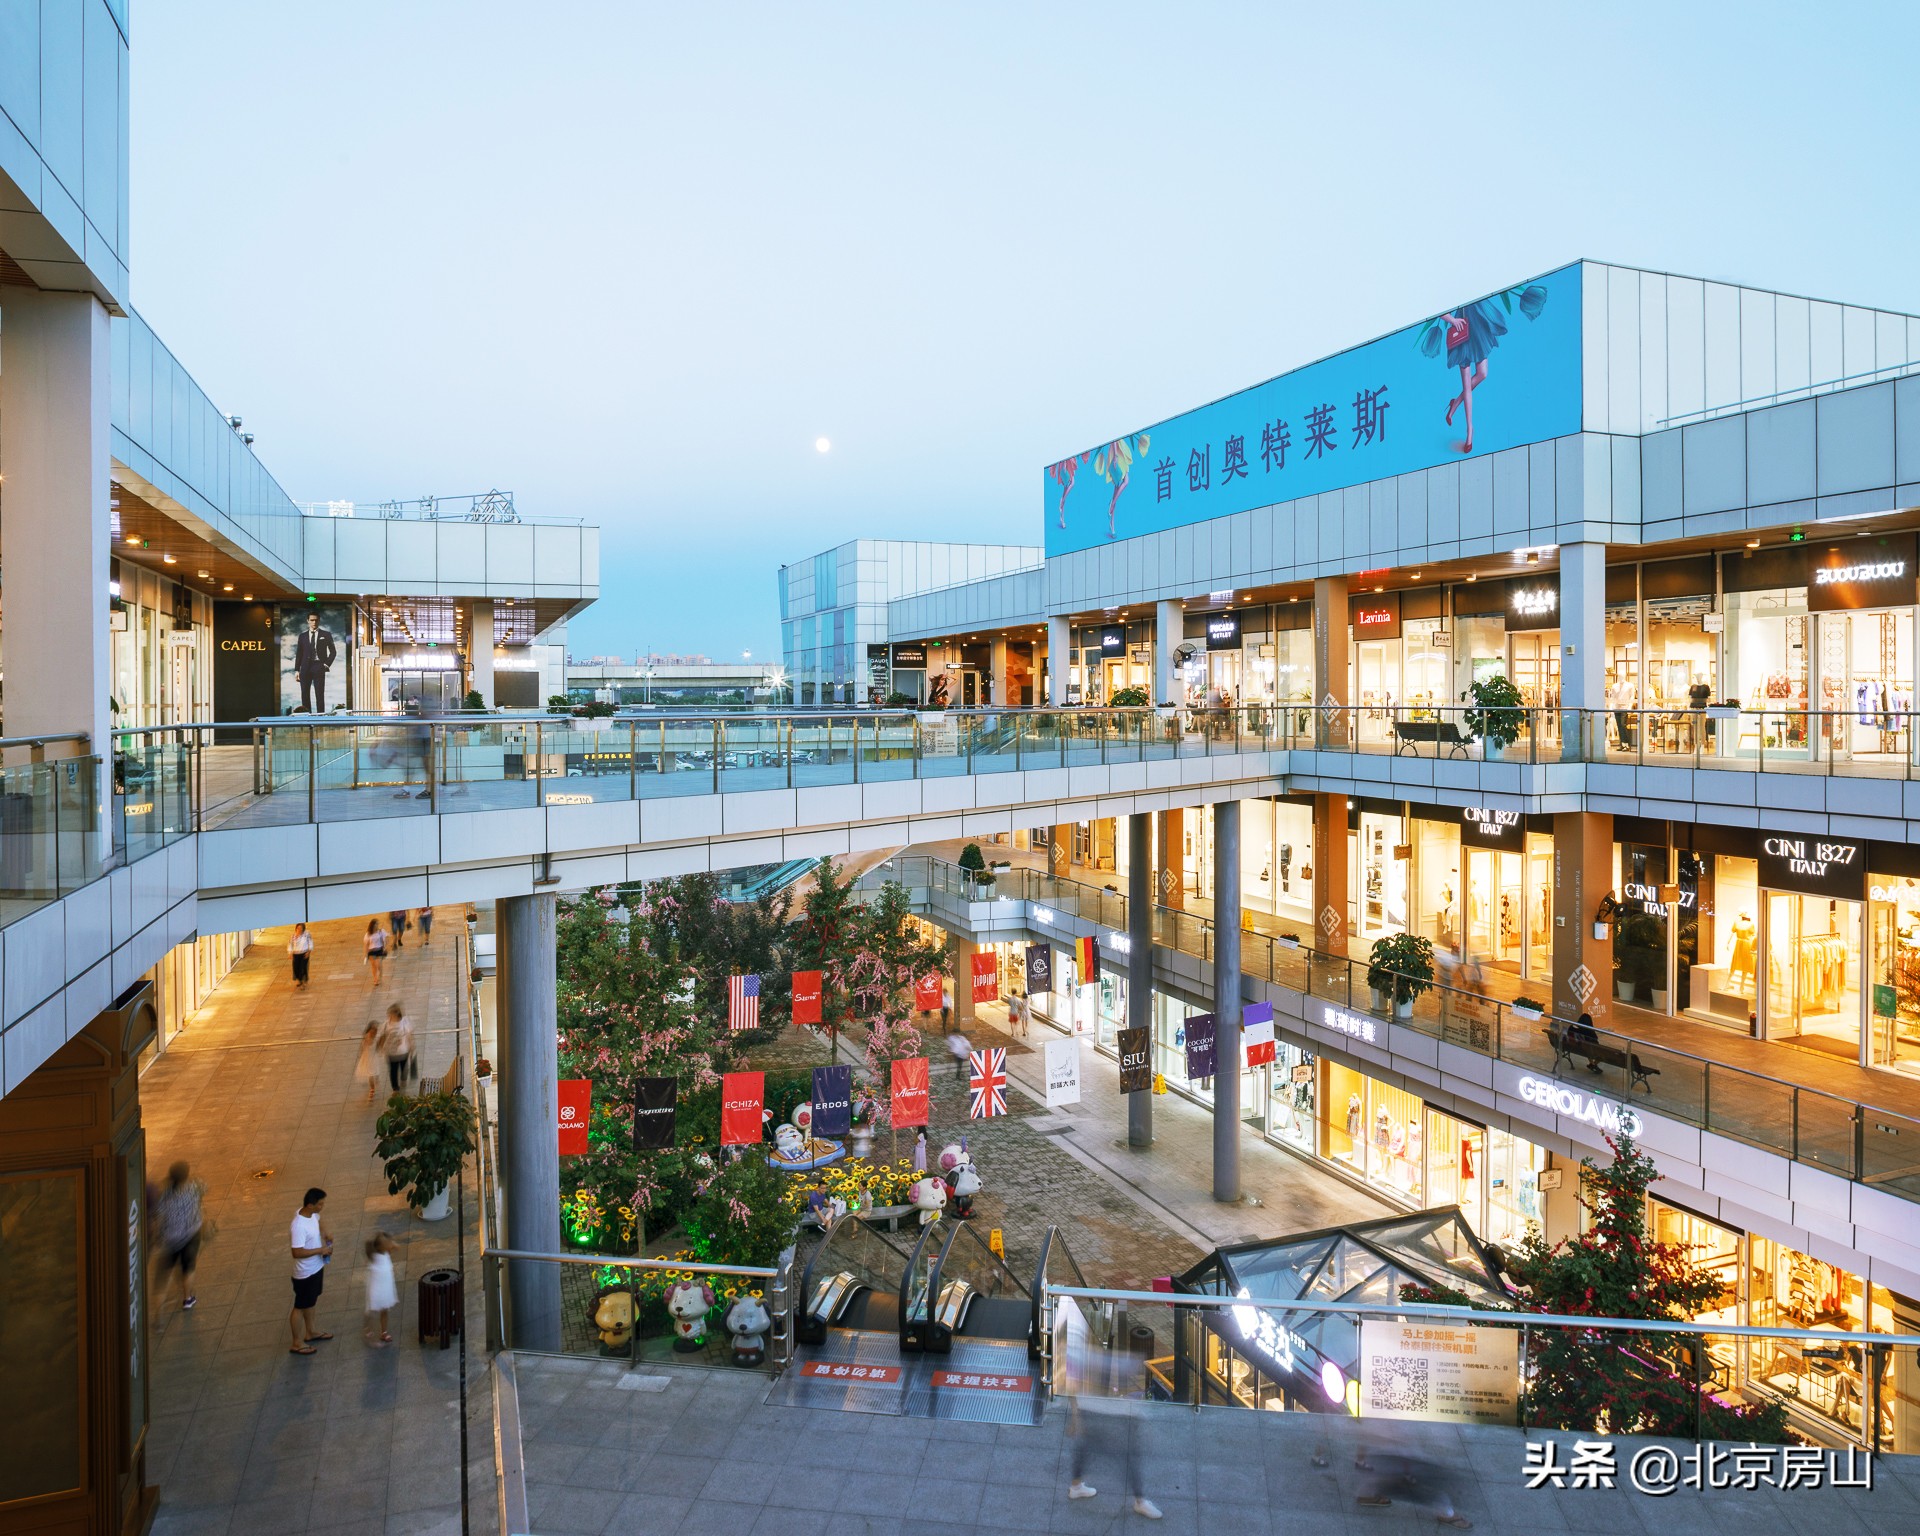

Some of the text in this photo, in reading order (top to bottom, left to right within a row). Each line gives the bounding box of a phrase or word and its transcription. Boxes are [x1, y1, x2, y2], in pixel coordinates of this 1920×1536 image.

[1153, 384, 1391, 504] 首创奥特莱斯
[1359, 610, 1391, 624] Lavinia
[221, 640, 266, 651] CAPEL
[1464, 807, 1519, 826] CINI 1827
[1479, 823, 1503, 835] ITALY
[1764, 838, 1856, 865] CINI 1827
[1789, 859, 1828, 876] ITALY
[1624, 883, 1656, 902] CINI
[1187, 1036, 1214, 1047] COCOON
[1123, 1051, 1146, 1067] SIU
[725, 1099, 760, 1109] ECHIZA
[815, 1100, 849, 1110] ERDOS
[1518, 1076, 1643, 1138] GEROLAMO
[1402, 1328, 1476, 1343] 马上参加摇一摇
[814, 1364, 886, 1379] 请勿停留
[946, 1374, 1018, 1388] 紧握扶手
